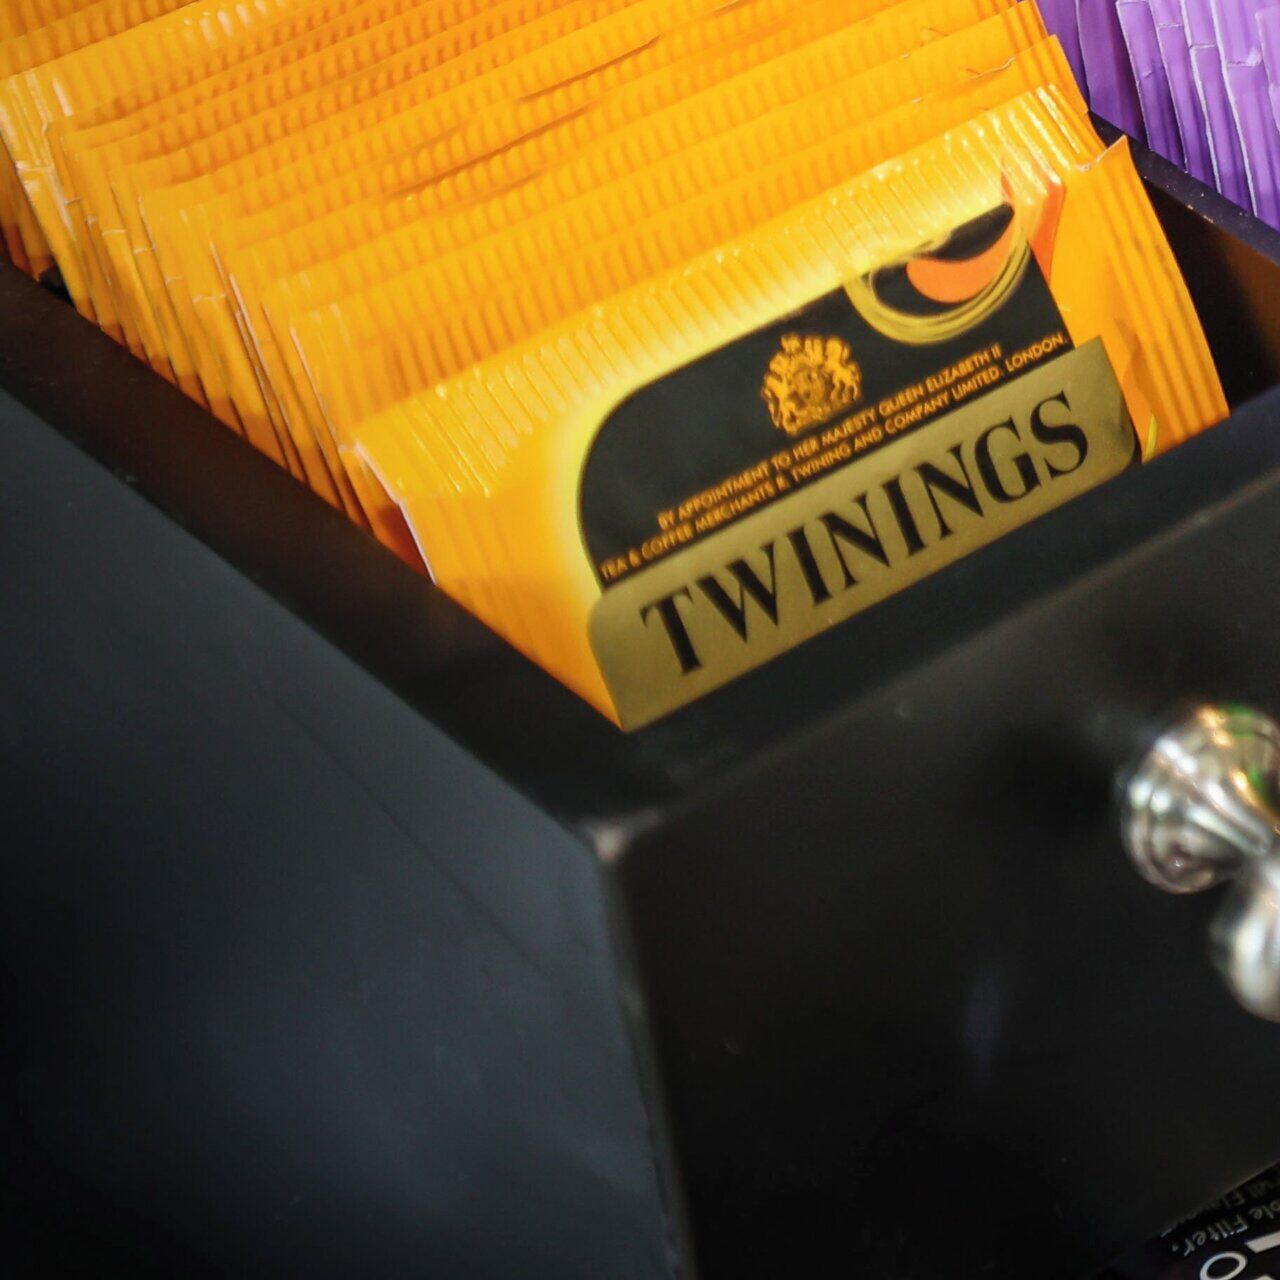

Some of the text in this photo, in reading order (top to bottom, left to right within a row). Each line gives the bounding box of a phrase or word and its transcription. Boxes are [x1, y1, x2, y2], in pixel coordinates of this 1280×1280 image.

[601, 556, 628, 579] TEA
[642, 523, 693, 559] COFFEE
[695, 481, 775, 532] MERCHANTS
[792, 444, 851, 482] TWINING
[854, 426, 883, 452] AND
[884, 390, 949, 435] COMPANY
[641, 390, 1091, 676] TWININGS
[657, 509, 675, 530] BY
[678, 460, 769, 521] APPOINTMENT
[770, 451, 791, 470] TO
[793, 436, 820, 460] HER
[821, 406, 875, 446] MAJESTY
[878, 383, 924, 416] QUEEN
[925, 350, 991, 392] ELIZABETH
